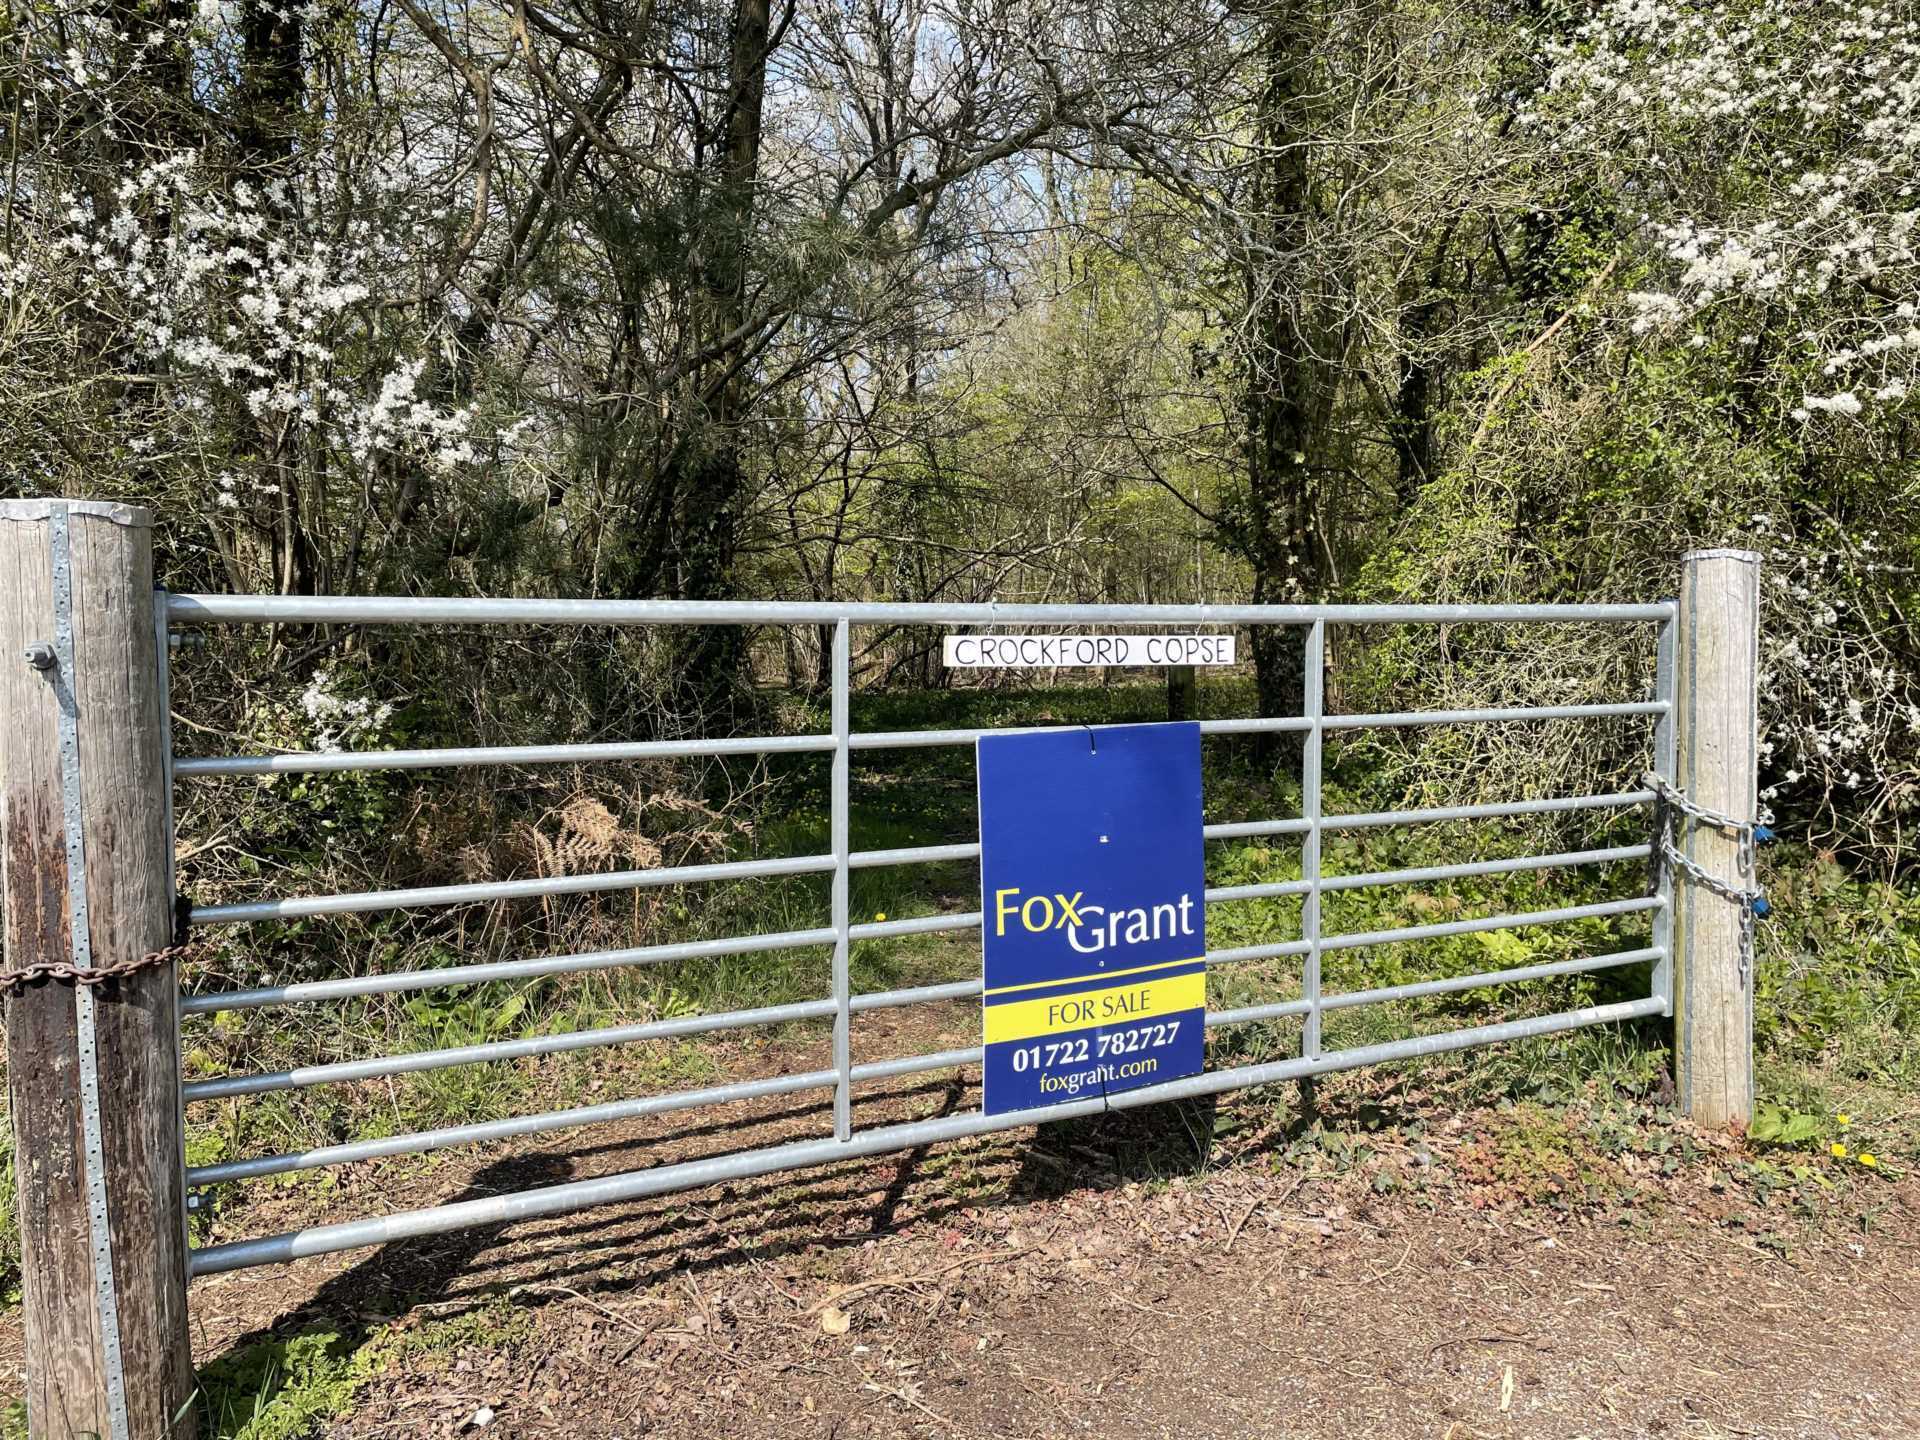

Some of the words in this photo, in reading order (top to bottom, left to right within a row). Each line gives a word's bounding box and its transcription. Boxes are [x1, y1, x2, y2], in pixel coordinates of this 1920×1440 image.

[955, 638, 1129, 665] CROCKFORD
[1147, 638, 1229, 664] COPSE
[1048, 999, 1096, 1026] FOR
[1102, 989, 1151, 1017] SALE
[1012, 1038, 1089, 1073] 01722
[1096, 1021, 1181, 1058] 782727
[1040, 1057, 1158, 1094] foxgrant.com
